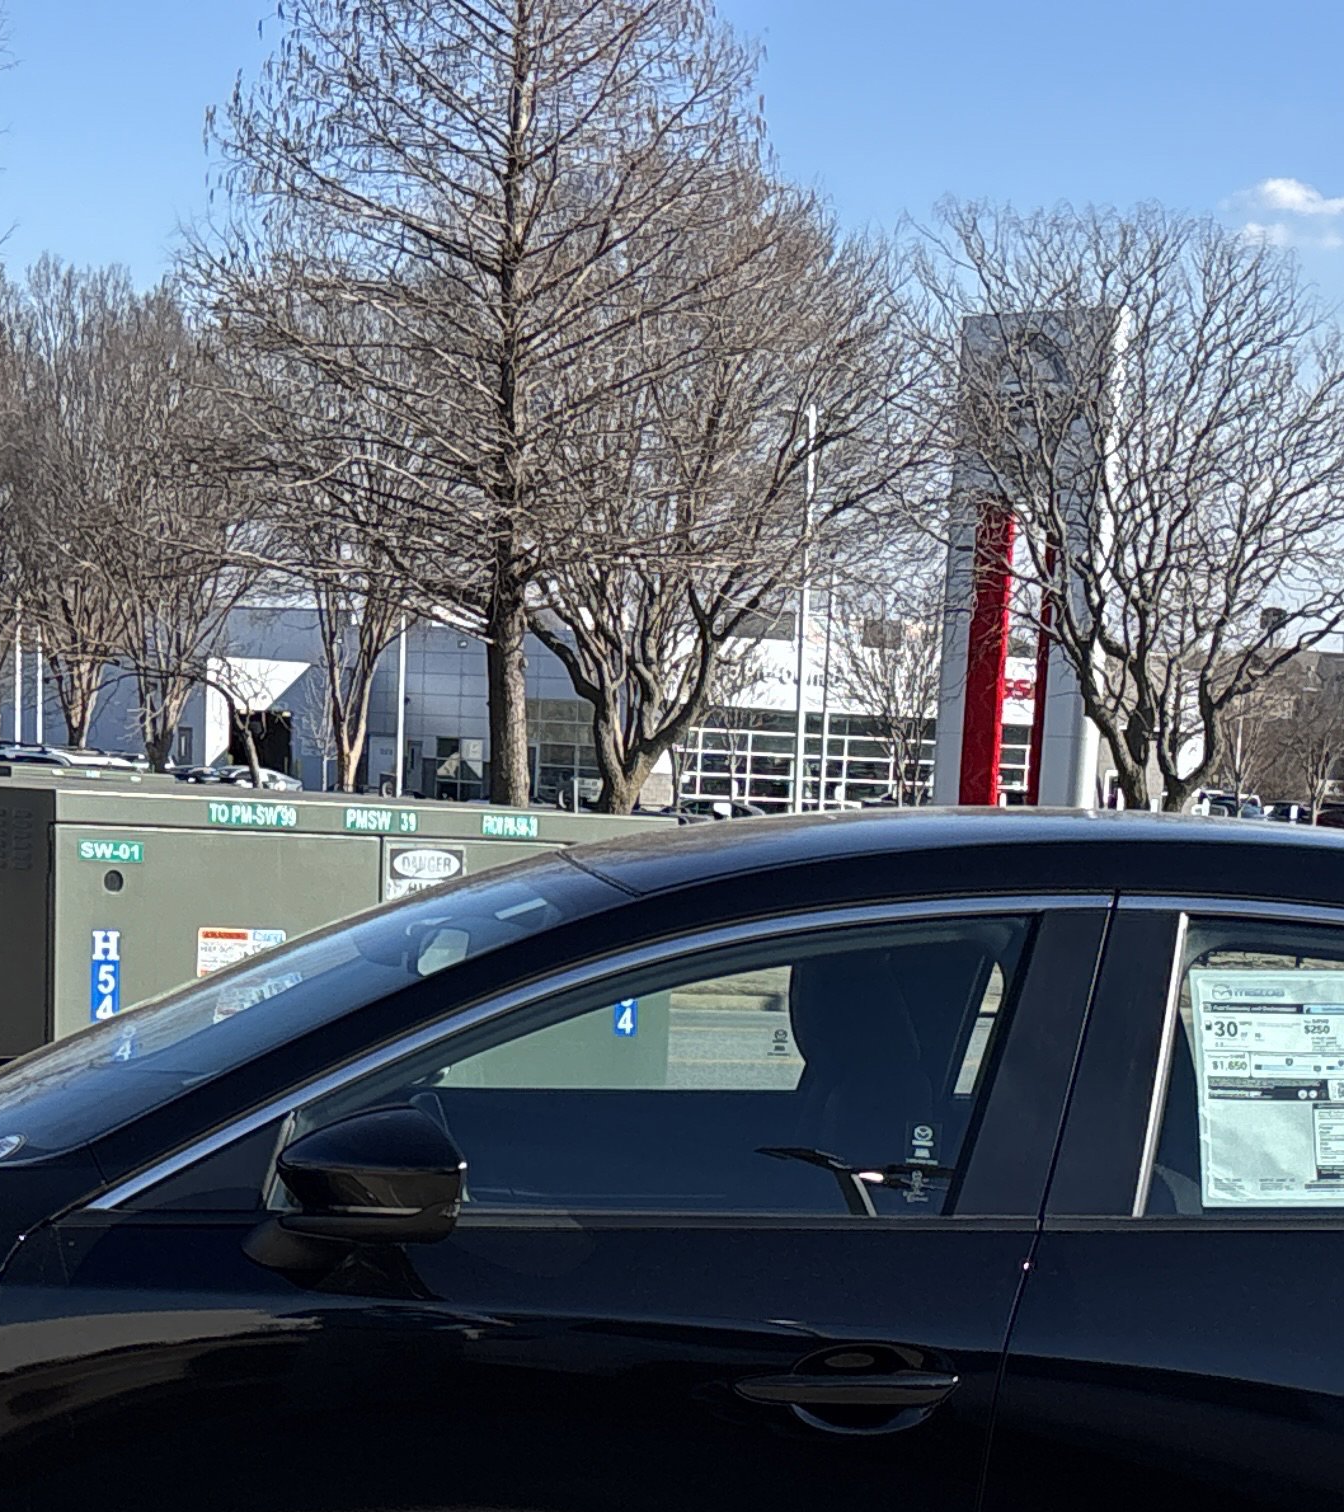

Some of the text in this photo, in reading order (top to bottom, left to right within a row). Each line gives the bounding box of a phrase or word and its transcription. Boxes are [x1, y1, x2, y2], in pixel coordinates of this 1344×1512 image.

[209, 803, 229, 823] TO
[346, 809, 417, 832] PMSW 39
[80, 841, 140, 861] SW-01
[401, 855, 452, 873] DANGER
[1214, 1020, 1238, 1038] 30
